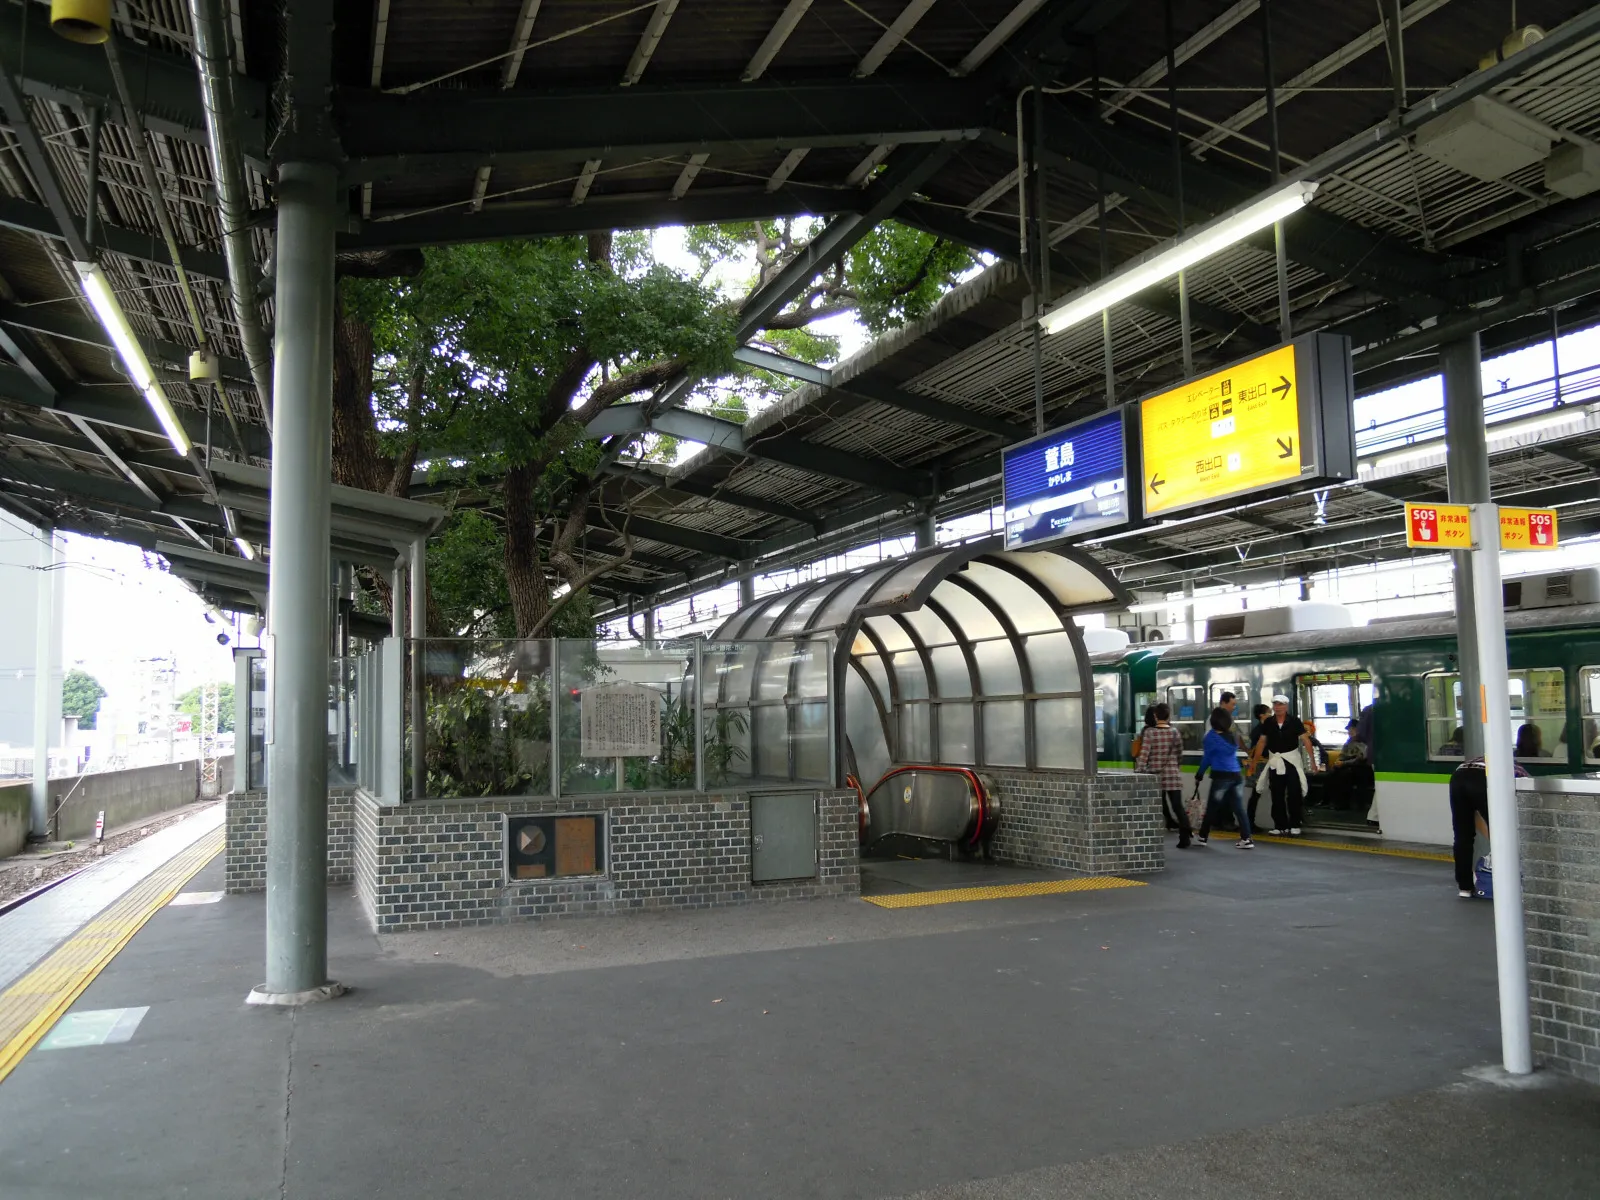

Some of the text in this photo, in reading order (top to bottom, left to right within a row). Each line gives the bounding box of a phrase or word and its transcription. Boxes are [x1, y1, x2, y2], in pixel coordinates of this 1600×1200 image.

[1187, 386, 1220, 403] エレベーター
[1238, 383, 1267, 405] 東出口
[1044, 441, 1075, 473] 萱島
[1195, 455, 1223, 474] 西出口
[1048, 470, 1072, 487] かやしま
[1413, 509, 1436, 520] SOS
[1440, 514, 1468, 524] 非常通報
[1530, 515, 1551, 525] SOS
[1500, 517, 1526, 526] 非常通報
[1444, 530, 1465, 538] ボタン
[1504, 531, 1524, 540] ボタン
